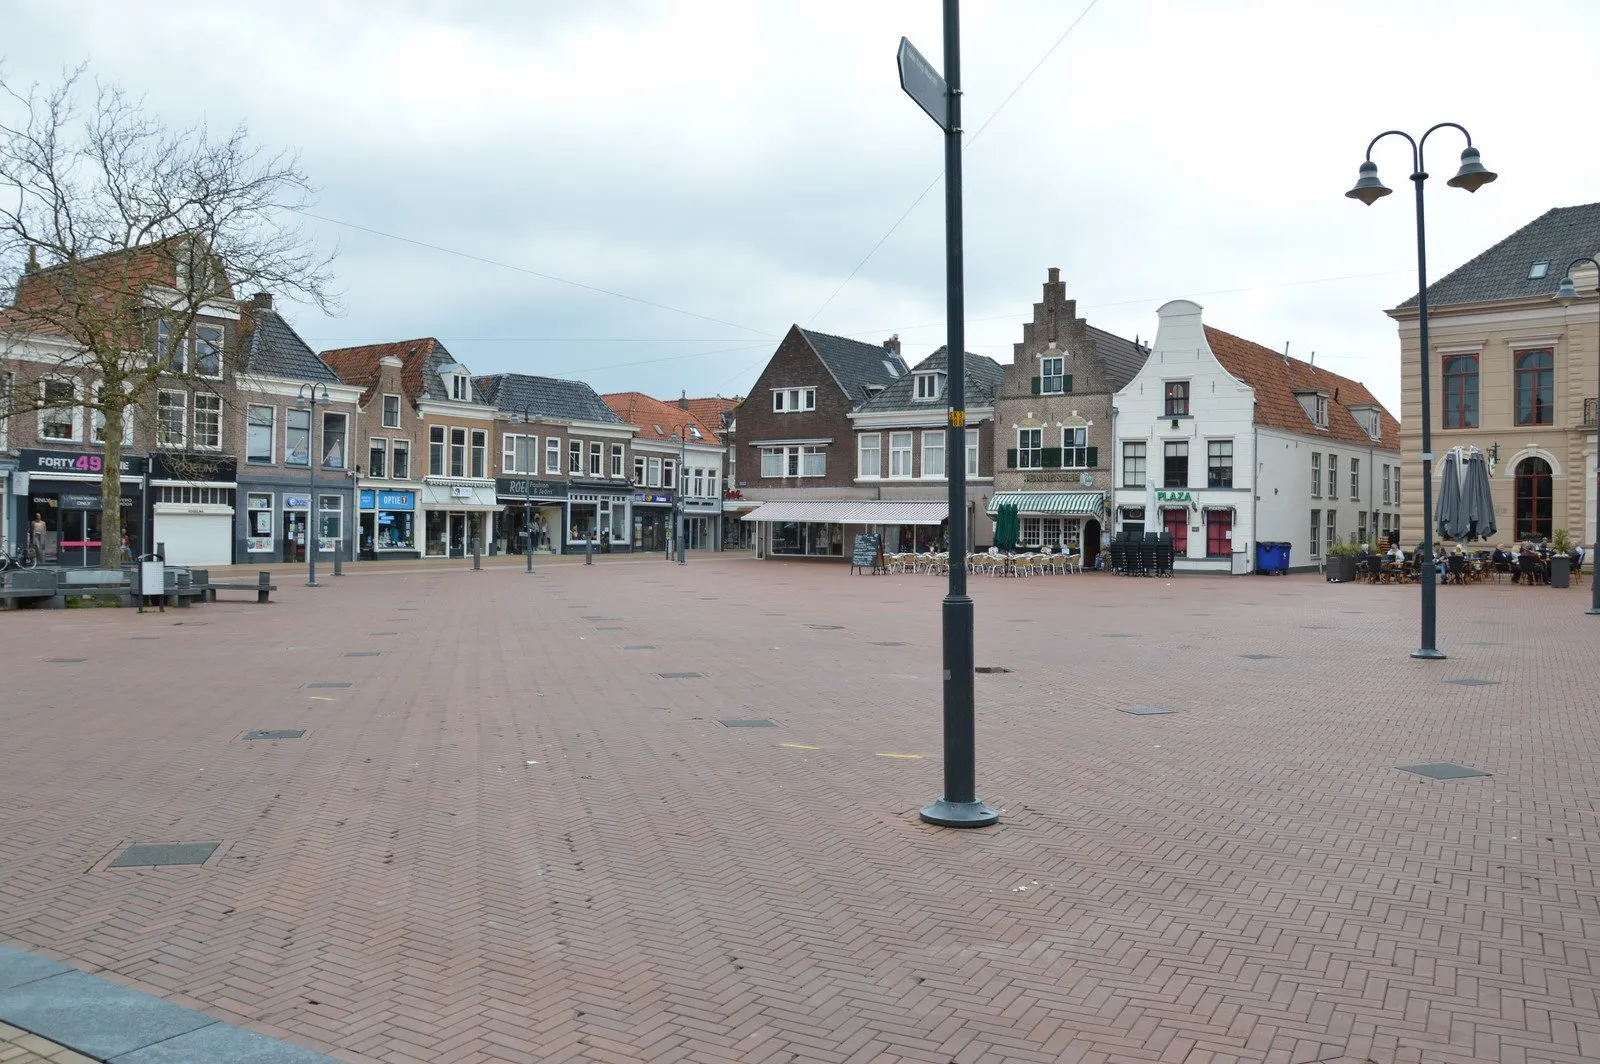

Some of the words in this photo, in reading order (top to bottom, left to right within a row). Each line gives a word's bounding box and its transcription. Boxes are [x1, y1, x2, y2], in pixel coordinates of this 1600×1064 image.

[38, 457, 75, 468] FORTY
[76, 455, 102, 471] 49
[1158, 492, 1192, 502] PLAZA
